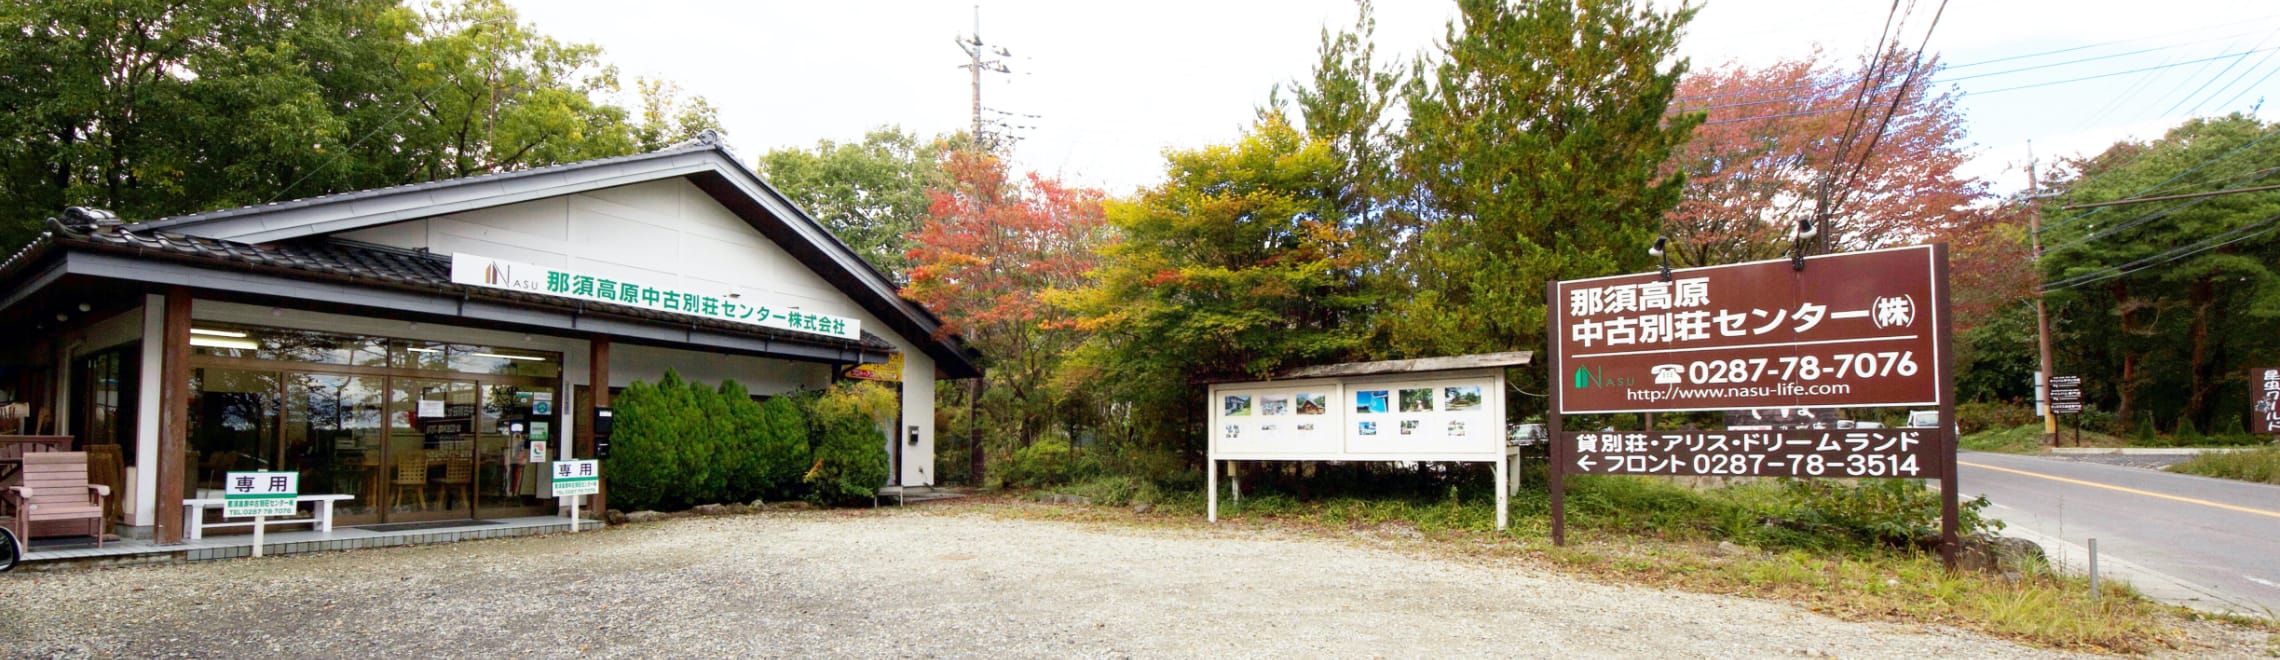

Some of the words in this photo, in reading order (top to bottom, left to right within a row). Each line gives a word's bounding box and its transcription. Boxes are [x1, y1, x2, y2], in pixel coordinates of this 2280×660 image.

[486, 261, 539, 290] NASU
[547, 271, 846, 336] 那須高原中古別荘センター株式会社
[1570, 277, 1711, 317] 那須高原
[1575, 364, 1636, 390] NASU
[1688, 351, 1919, 386] 0287-78-7076
[1626, 382, 1851, 403] http://www.nasu-life.com
[1576, 432, 1920, 453] 貸別荘・アリス・ドリームランド
[1604, 454, 1687, 474] フロント
[1693, 454, 1921, 477] 0287-78-3514
